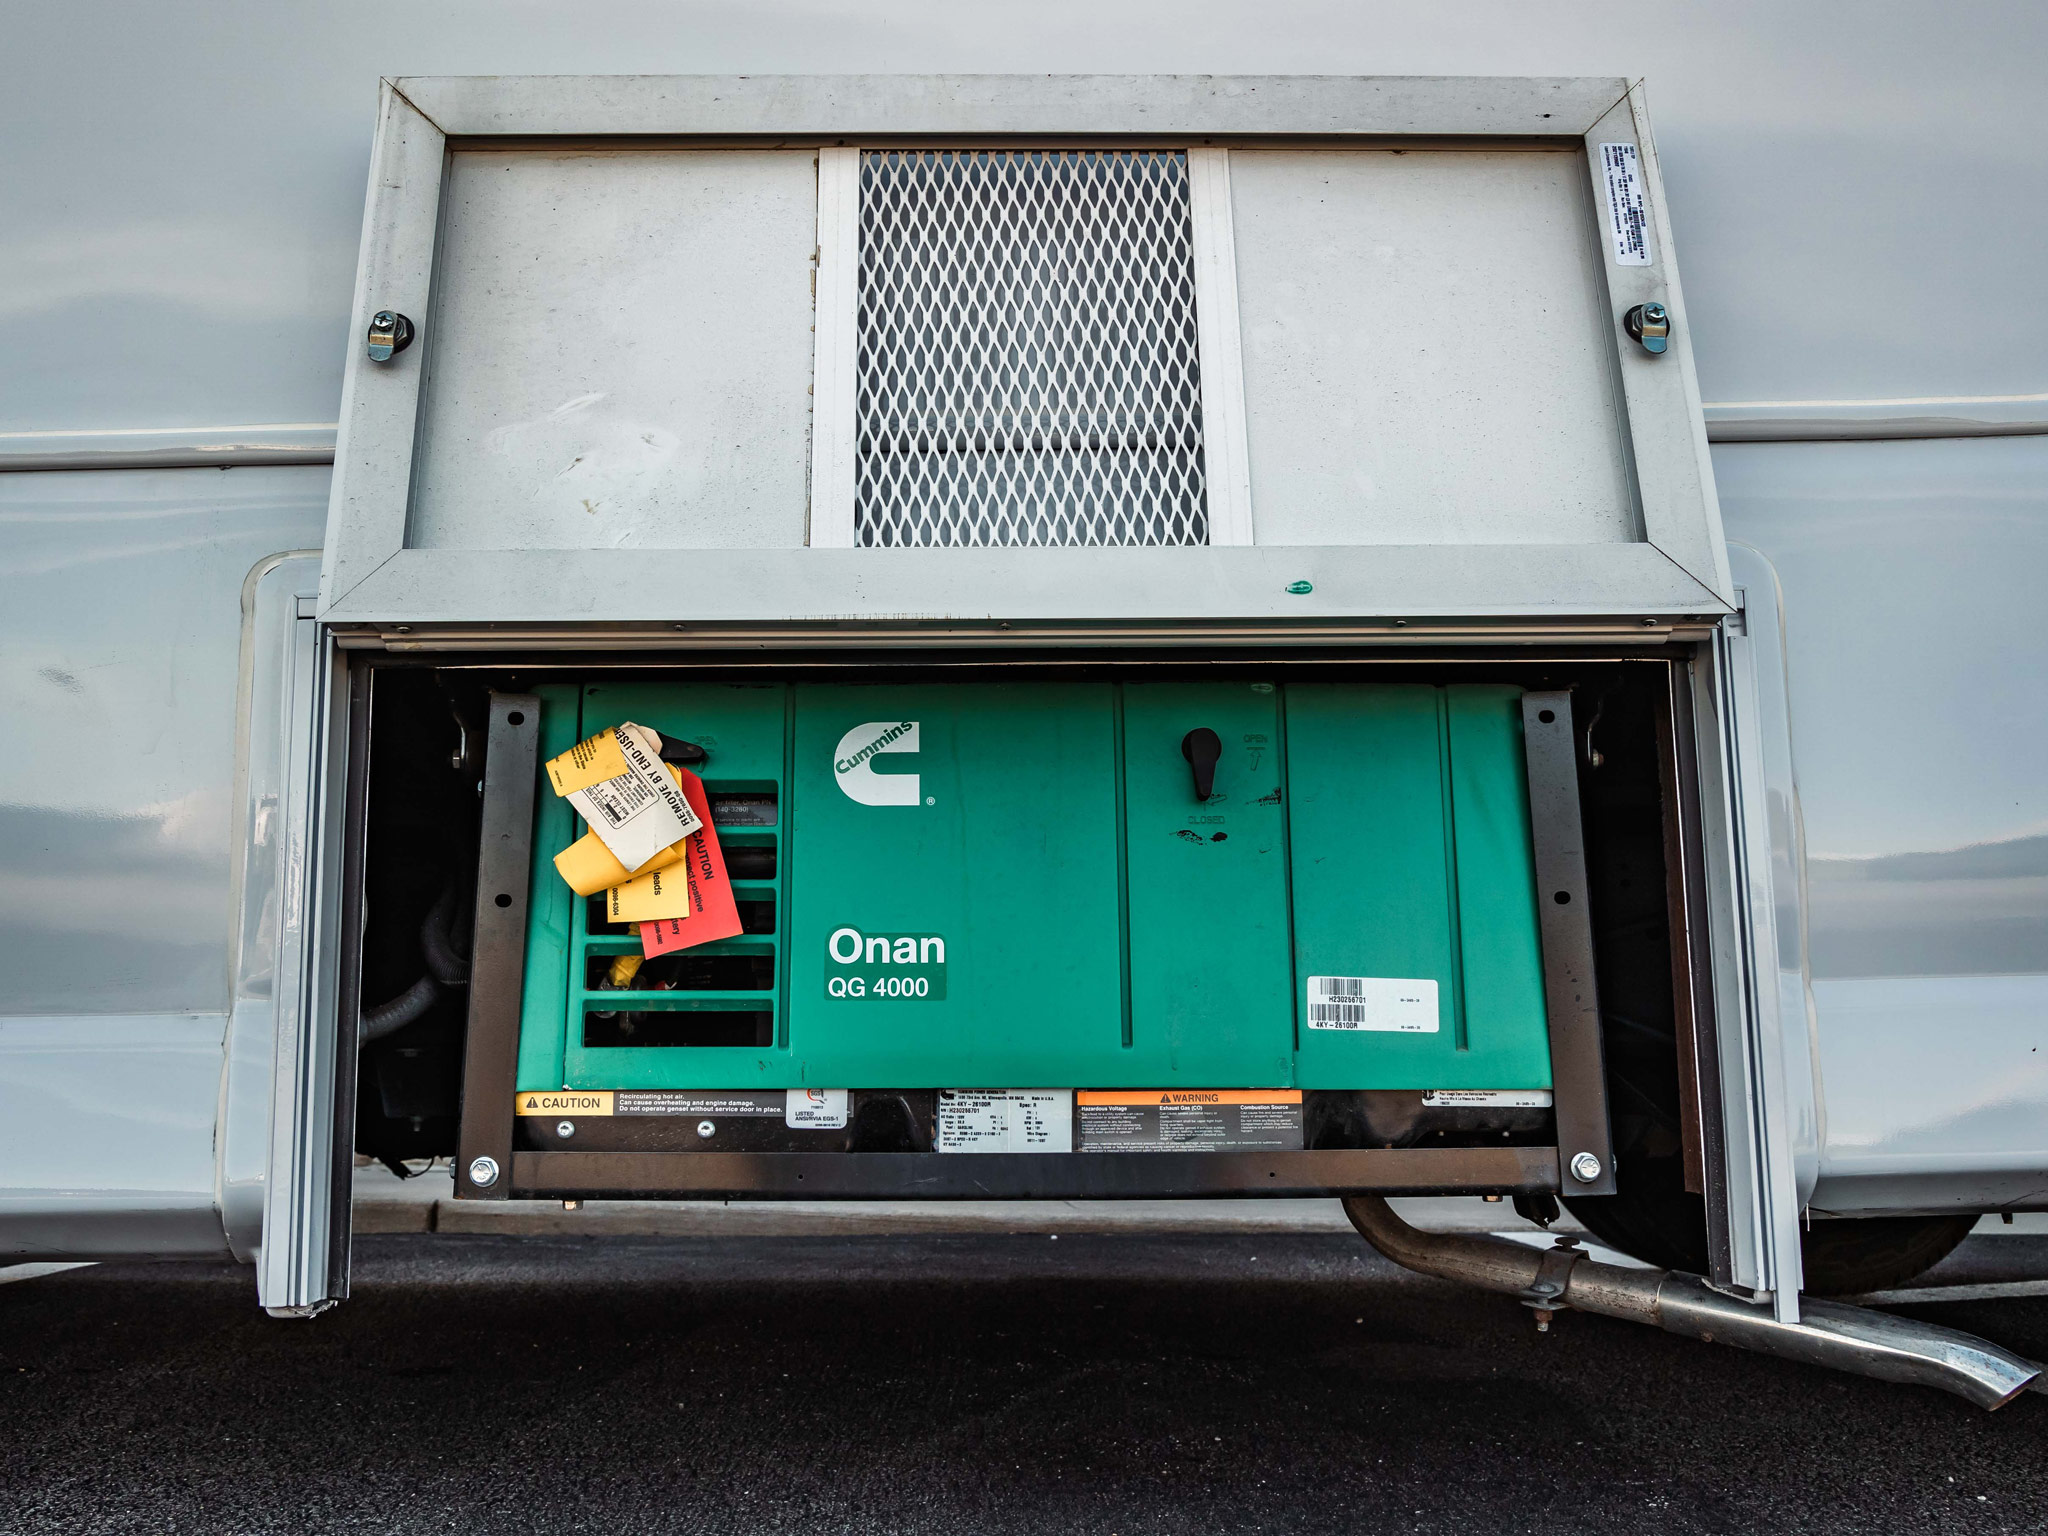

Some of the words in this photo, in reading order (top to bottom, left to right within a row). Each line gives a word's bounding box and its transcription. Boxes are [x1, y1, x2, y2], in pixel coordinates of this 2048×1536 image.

[1243, 734, 1268, 743] OPEN
[836, 720, 913, 775] Cummins
[647, 770, 663, 785] BY
[585, 788, 594, 797] THIS
[596, 800, 607, 812] INDEX
[611, 794, 622, 807] CLEAN
[658, 784, 690, 827] REMOVE
[604, 810, 612, 818] AIR
[619, 805, 630, 816] MOST
[610, 817, 618, 825] THE
[1188, 816, 1225, 824] CLOSED
[692, 829, 714, 880] CAUTION
[653, 872, 662, 896] leads
[689, 880, 704, 913] positive
[829, 928, 945, 964] Onan
[828, 977, 866, 998] QG
[873, 977, 929, 997] 4000
[542, 1097, 600, 1109] CAUTION
[653, 1100, 691, 1108] overheating
[705, 1100, 727, 1108] engine
[1172, 1094, 1219, 1103] WARNING
[763, 1106, 783, 1114] place.
